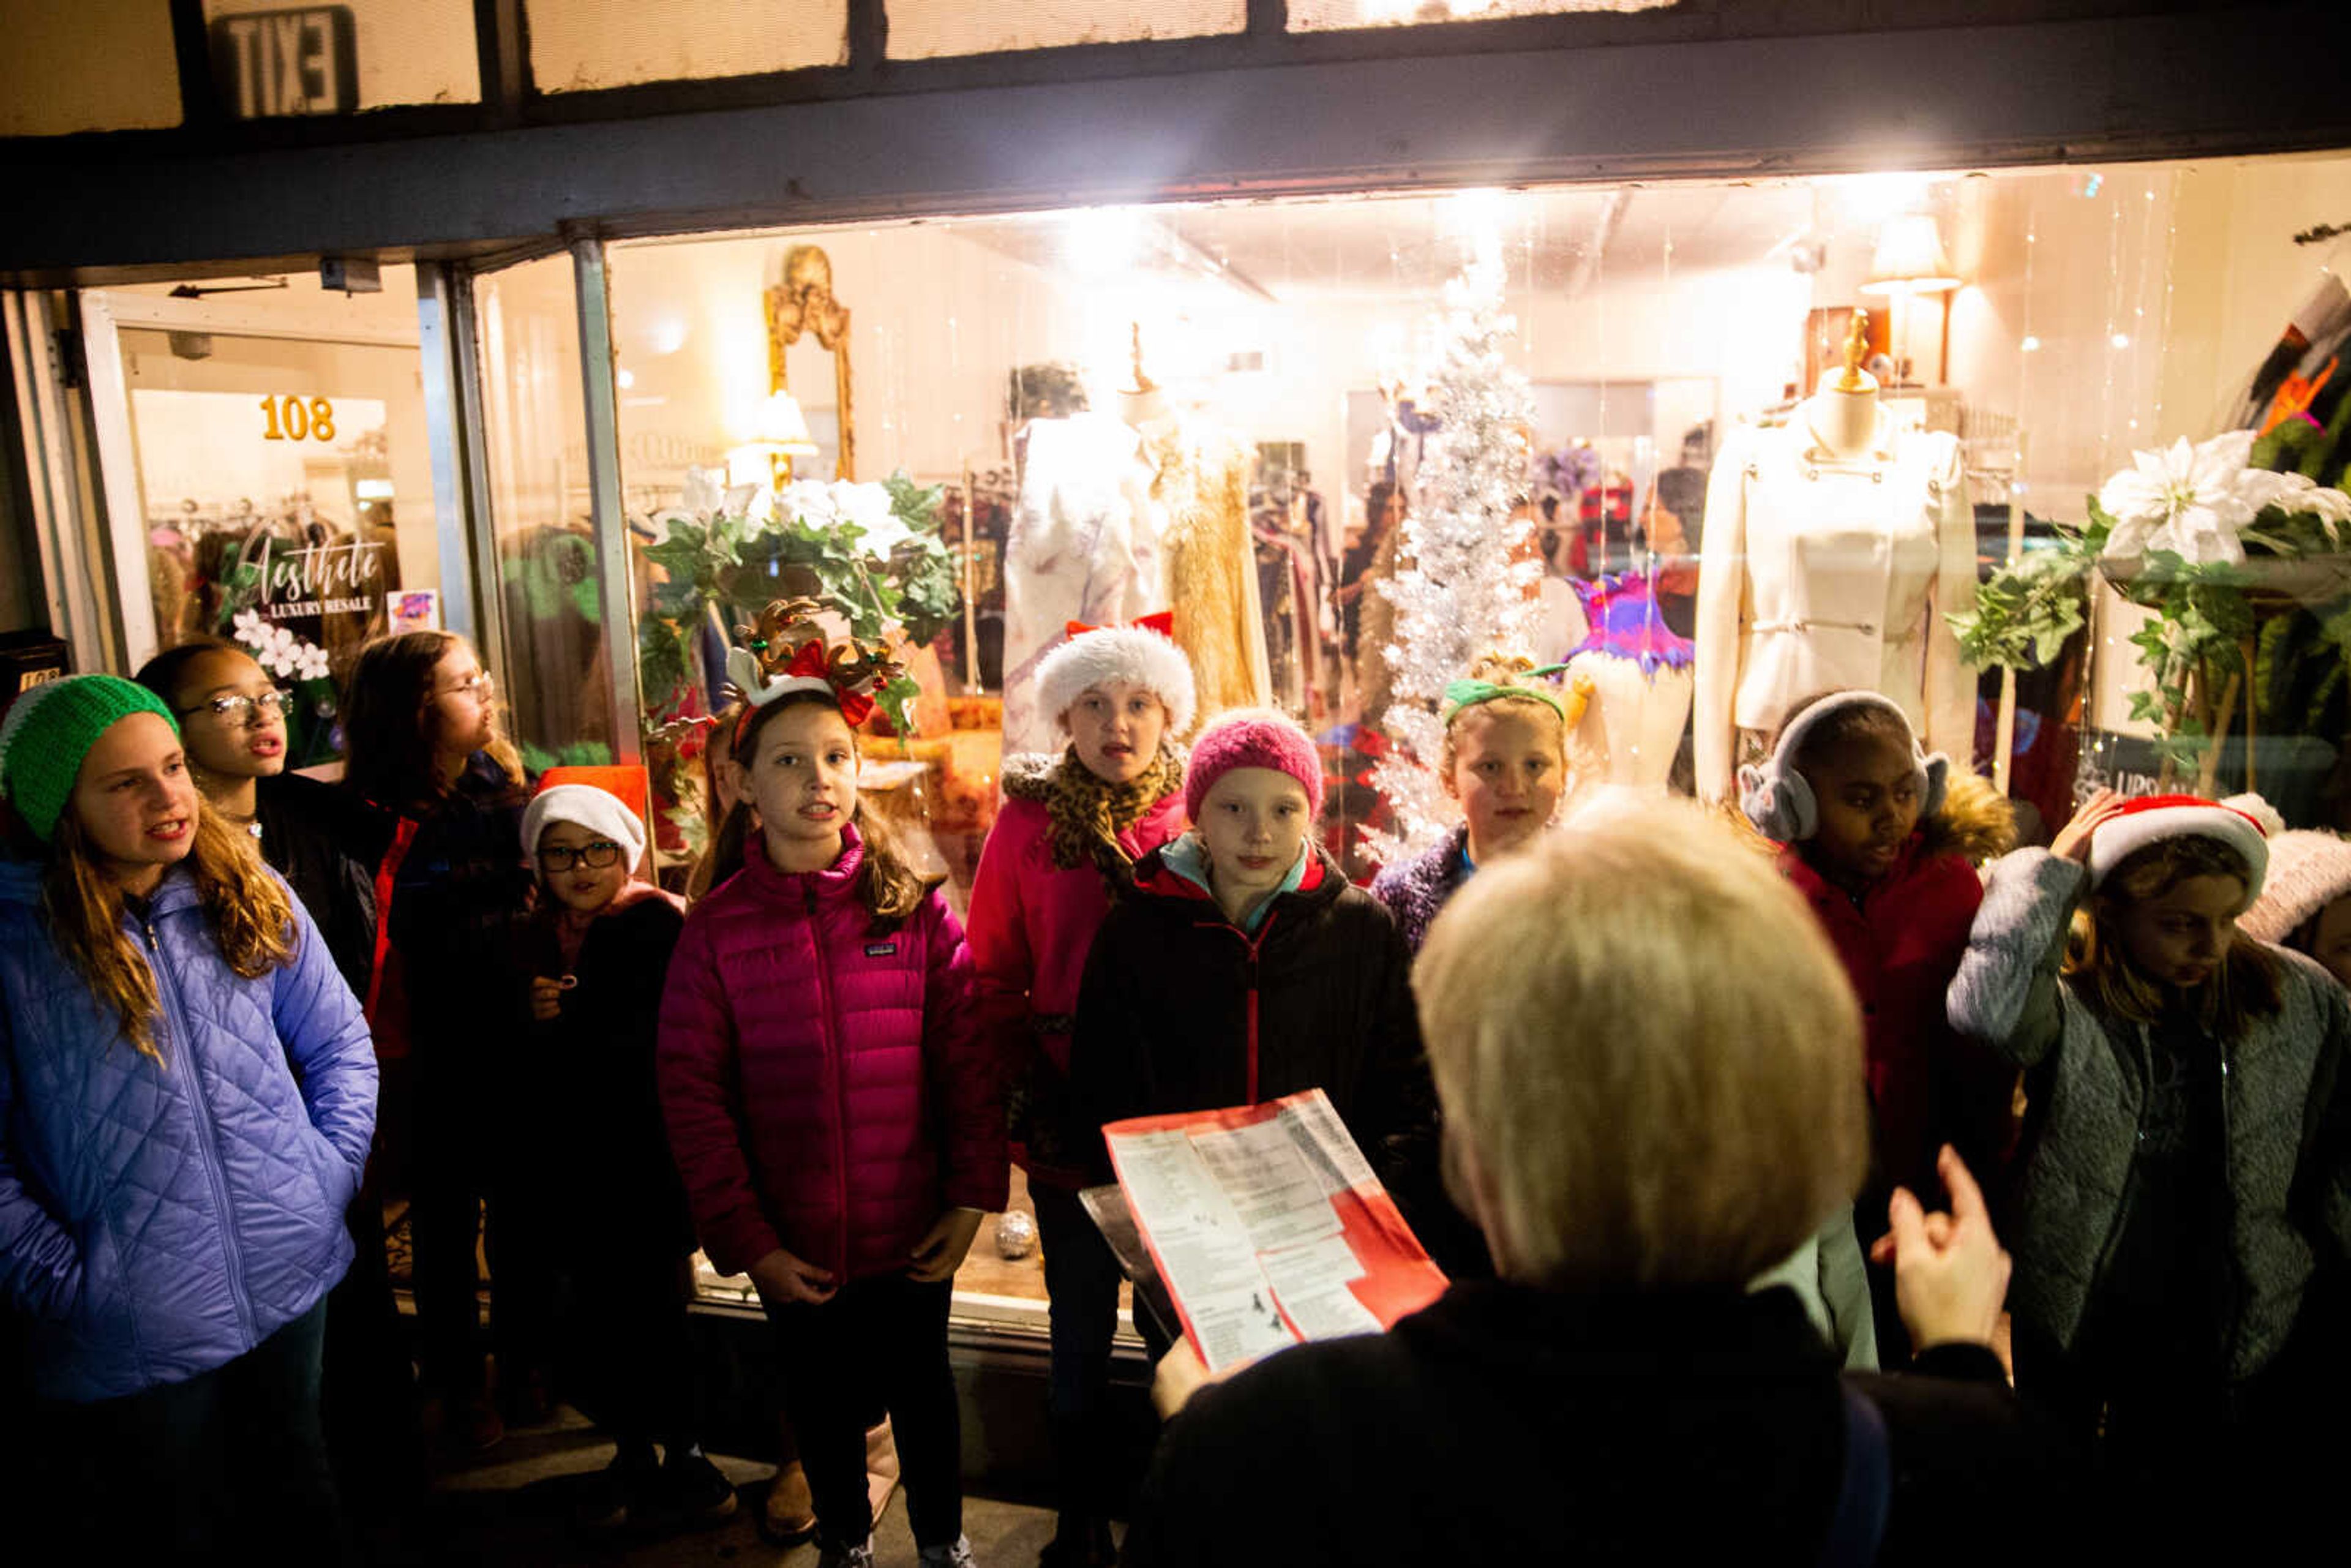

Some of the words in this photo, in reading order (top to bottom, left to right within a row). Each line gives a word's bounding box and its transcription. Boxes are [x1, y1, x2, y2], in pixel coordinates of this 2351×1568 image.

[260, 395, 336, 441] 108
[239, 534, 386, 606] Aesthete
[271, 601, 321, 618] LUXURY
[325, 596, 371, 613] RESALE
